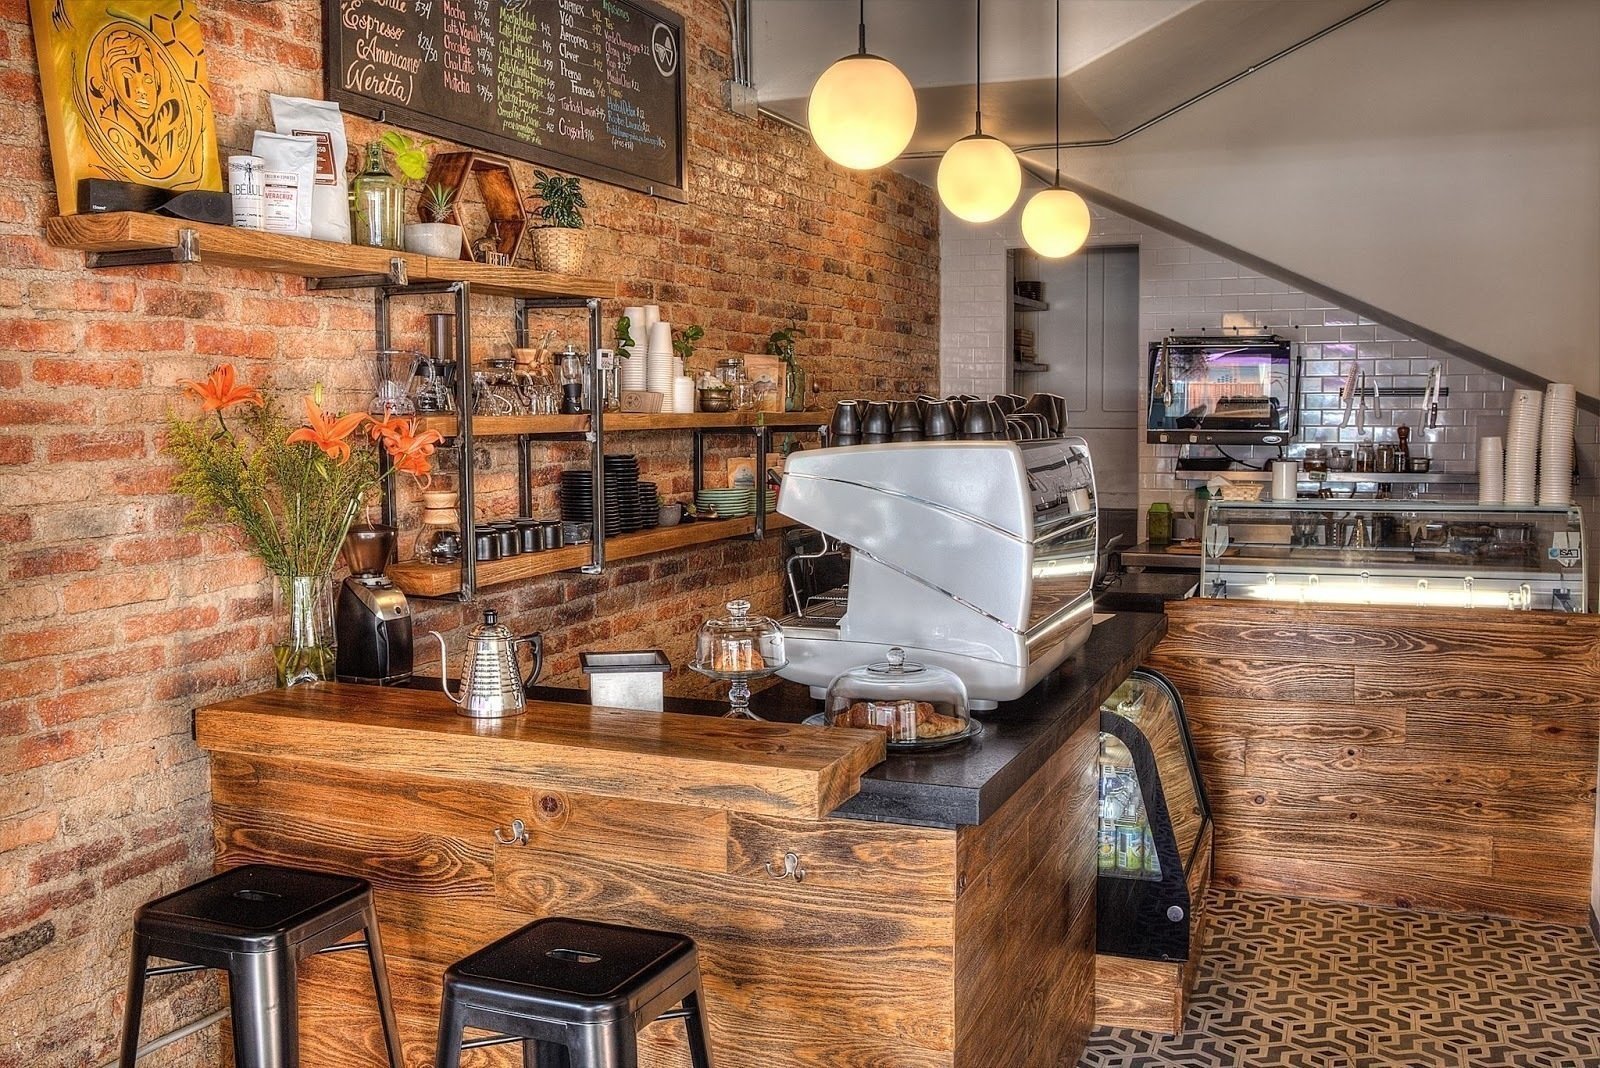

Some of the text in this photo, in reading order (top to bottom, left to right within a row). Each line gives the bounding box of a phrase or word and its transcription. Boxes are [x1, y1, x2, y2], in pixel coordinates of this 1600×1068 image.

[443, 0, 466, 21] Mocha
[560, 10, 574, 28] V60
[342, 7, 405, 40] Espresso
[443, 17, 459, 36] Latte
[560, 25, 589, 50] Aeropress
[356, 36, 422, 74] Americano
[559, 43, 580, 63] Clever
[560, 59, 582, 81] Prensa
[570, 79, 596, 98] Francesa
[265, 192, 294, 200] VERACRUZ
